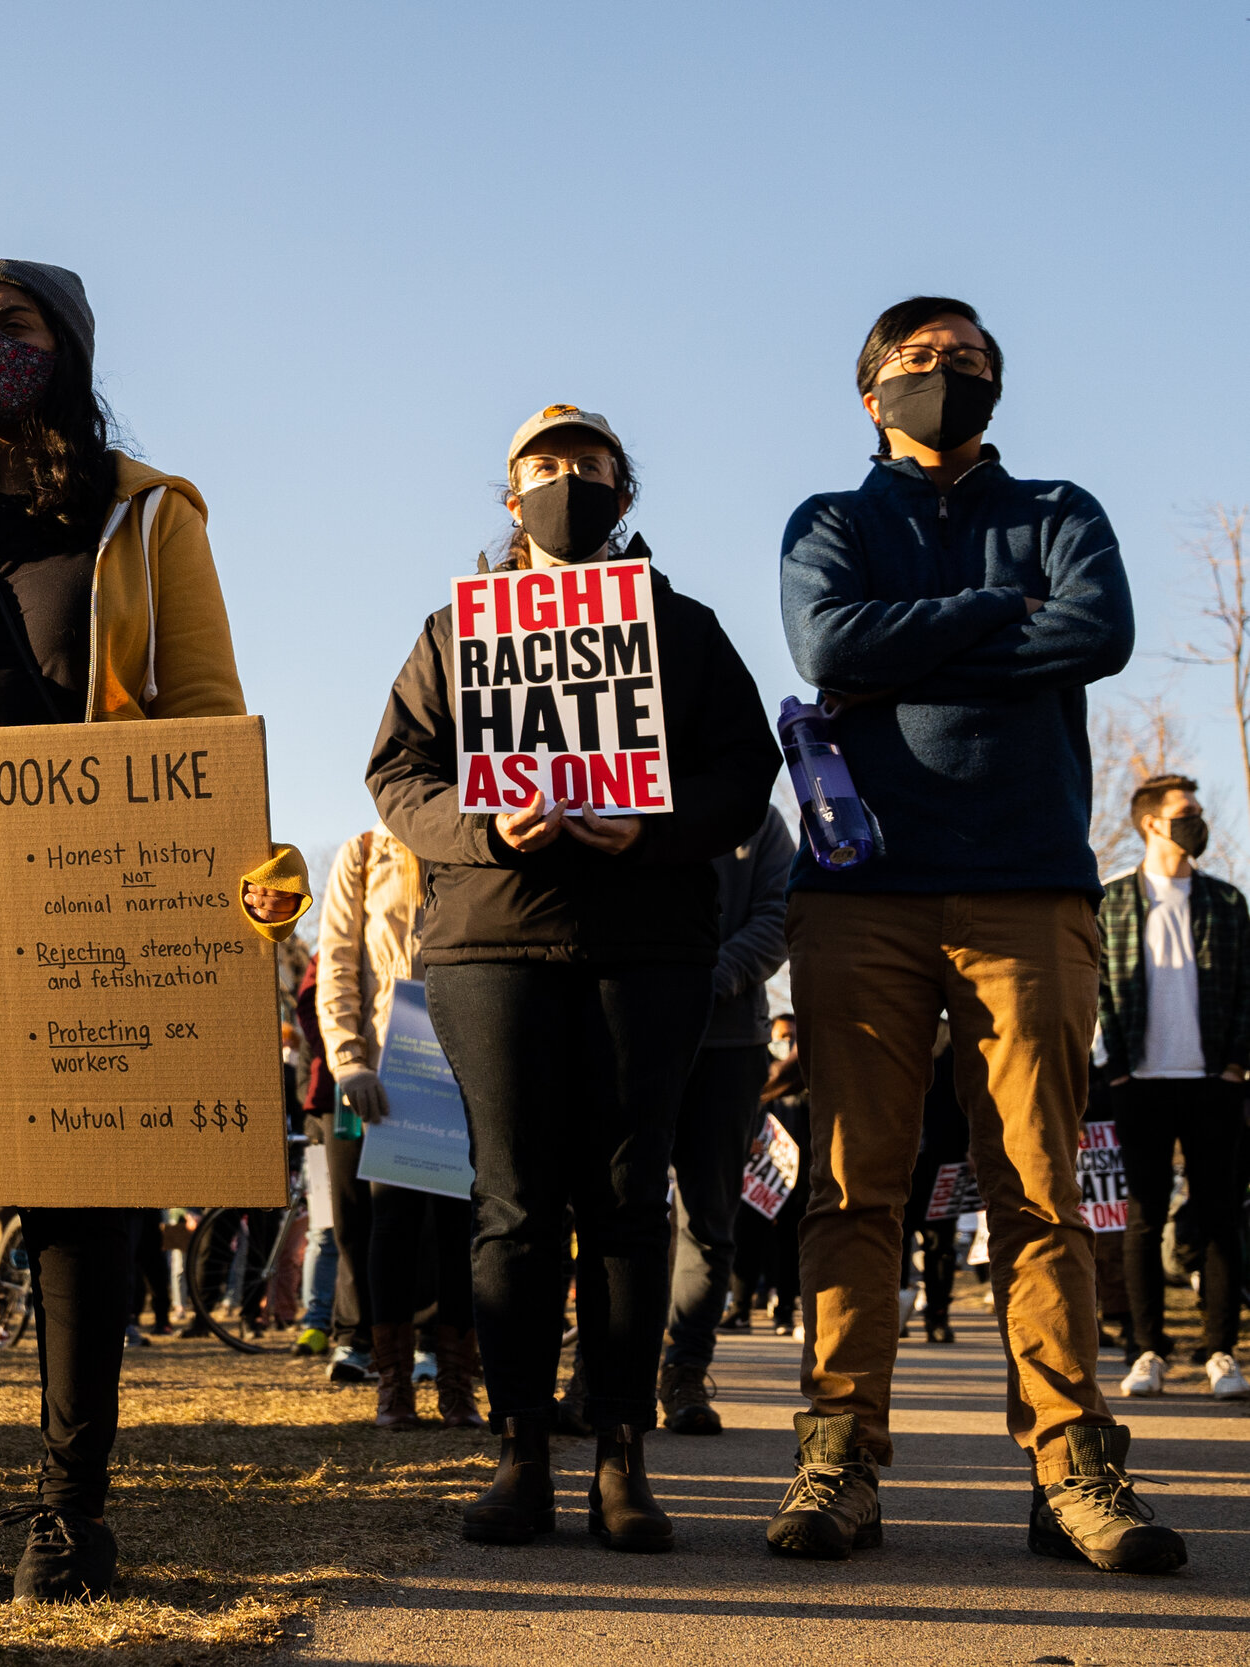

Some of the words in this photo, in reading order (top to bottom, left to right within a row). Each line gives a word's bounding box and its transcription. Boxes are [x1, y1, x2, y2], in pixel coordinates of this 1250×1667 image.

[456, 564, 644, 638] FIGHT
[459, 622, 652, 688] RACISM
[461, 675, 660, 753] HATE
[126, 751, 212, 803] LIKE
[464, 754, 539, 807] AS
[551, 751, 665, 810] ONE
[47, 842, 126, 869] Honest
[138, 841, 215, 877] history
[123, 871, 152, 884] NOT
[44, 894, 112, 914] colonial
[126, 891, 230, 912] narratives
[36, 941, 126, 970] Rejecting
[140, 936, 244, 964] stereotypes
[47, 969, 82, 990] and
[91, 965, 217, 988] fetishization
[48, 1019, 150, 1050] Protecting
[165, 1022, 199, 1040] sex
[51, 1051, 129, 1073] workers
[51, 1106, 125, 1133] Mutual
[140, 1105, 173, 1128] aid
[190, 1099, 249, 1133] $$$
[1082, 1173, 1128, 1203] ATE
